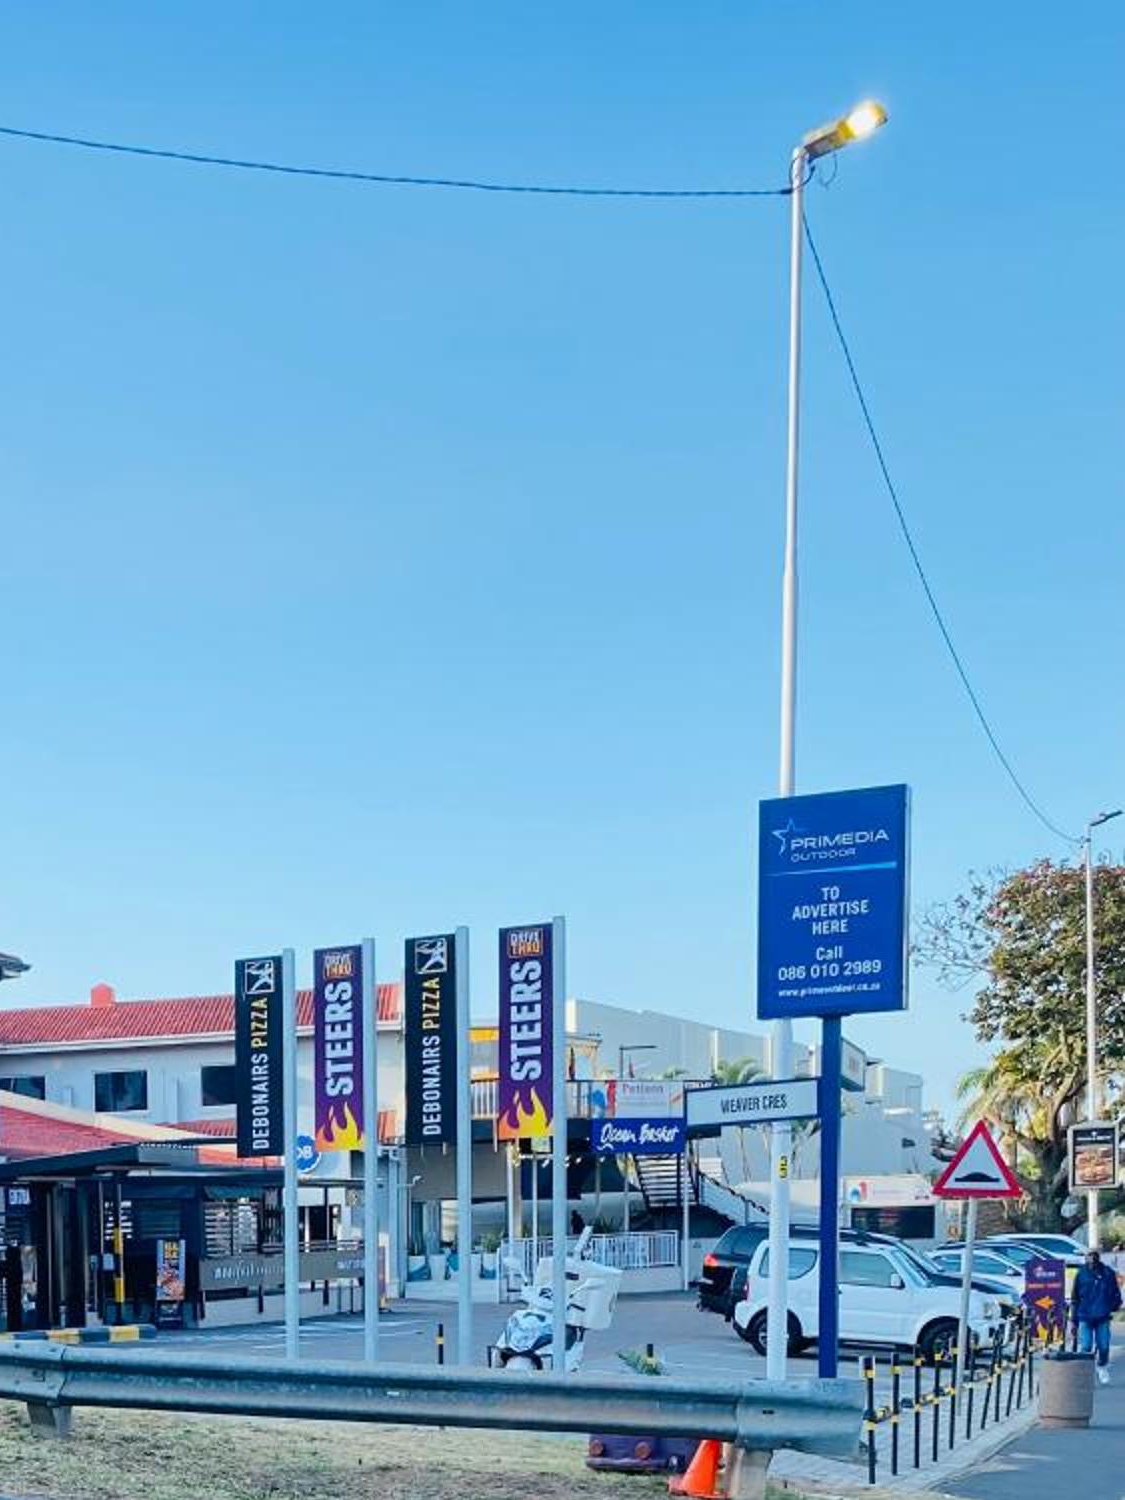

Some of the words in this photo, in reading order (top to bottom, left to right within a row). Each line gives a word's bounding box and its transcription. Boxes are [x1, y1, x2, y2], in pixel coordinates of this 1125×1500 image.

[790, 828, 890, 850] PRIMEDIA
[790, 847, 856, 862] OUTDOOR
[822, 886, 840, 900] TO
[792, 900, 869, 921] ADVERTISE
[812, 919, 849, 935] HERE
[816, 945, 843, 961] Call
[778, 965, 806, 981] 086
[810, 962, 840, 979] 010
[843, 959, 882, 976] 2989
[421, 977, 440, 1030] PIZZA
[250, 997, 268, 1048] PIZZA
[510, 960, 542, 1081] STEERS
[325, 981, 354, 1097] STEERS
[422, 1035, 441, 1136] DEBONAIRS
[250, 1053, 270, 1150] DEBONAIRS
[720, 1097, 760, 1114] WEAVER
[762, 1094, 788, 1110] CRES
[600, 1122, 638, 1144] Ocean
